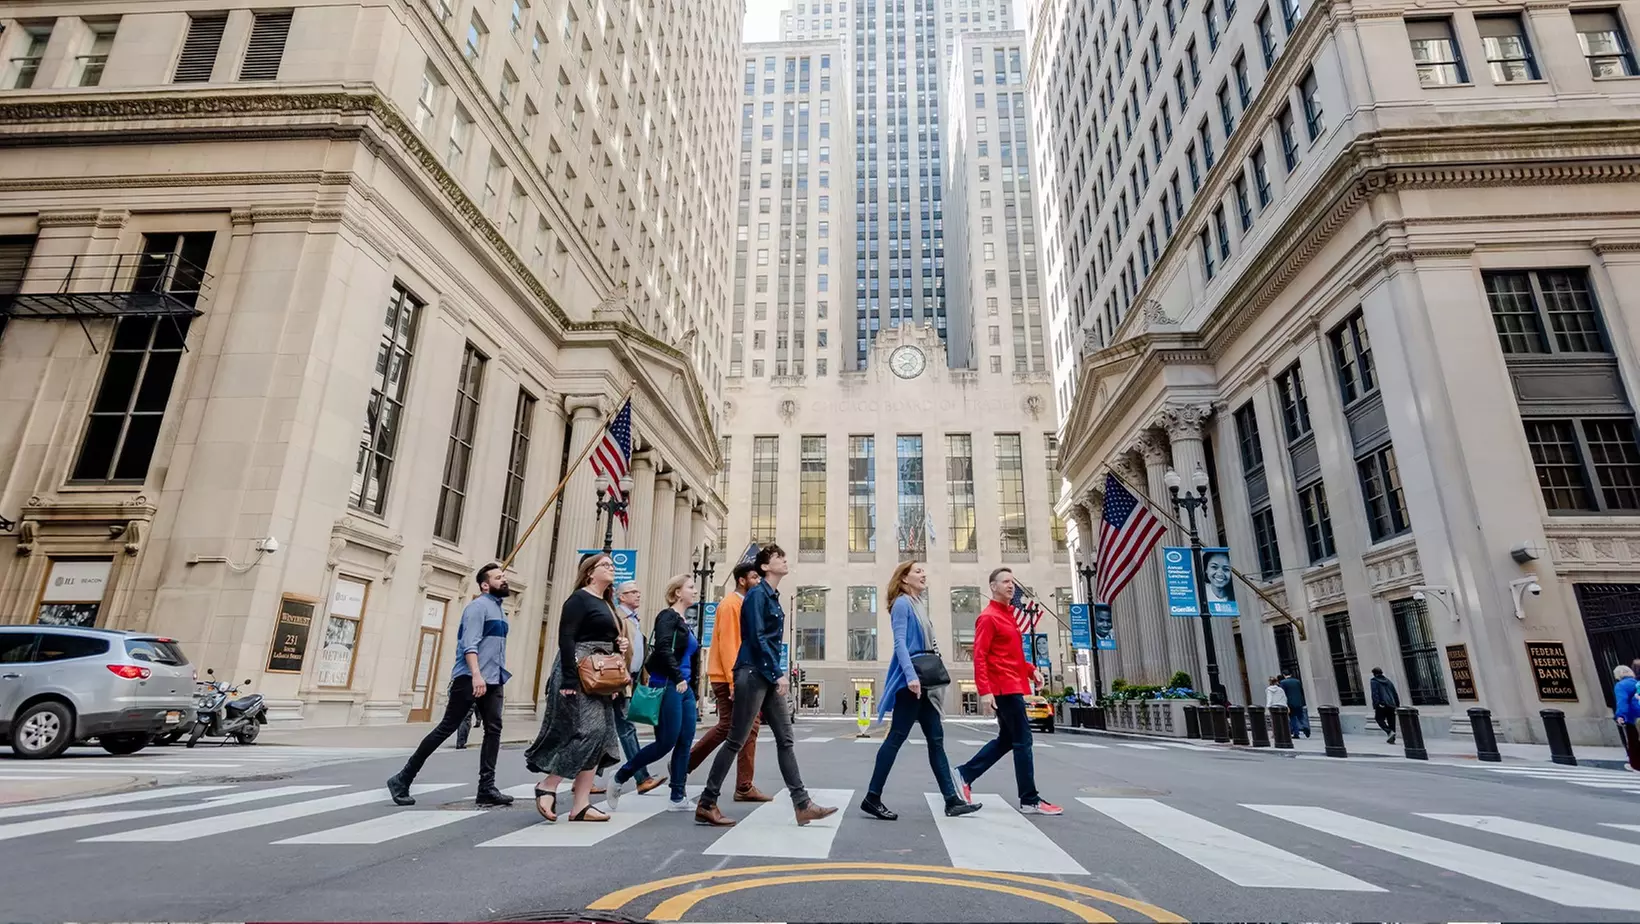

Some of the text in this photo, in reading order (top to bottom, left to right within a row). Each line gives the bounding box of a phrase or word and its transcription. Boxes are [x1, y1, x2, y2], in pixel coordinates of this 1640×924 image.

[811, 399, 880, 413] CHICAGO
[884, 399, 934, 413] BOARD
[282, 612, 311, 624] WINTRUST
[285, 634, 298, 646] 231
[1530, 647, 1565, 656] FEDERAL
[1533, 658, 1567, 667] RESERVE
[318, 670, 347, 684] LEASE
[1538, 668, 1569, 679] BANK
